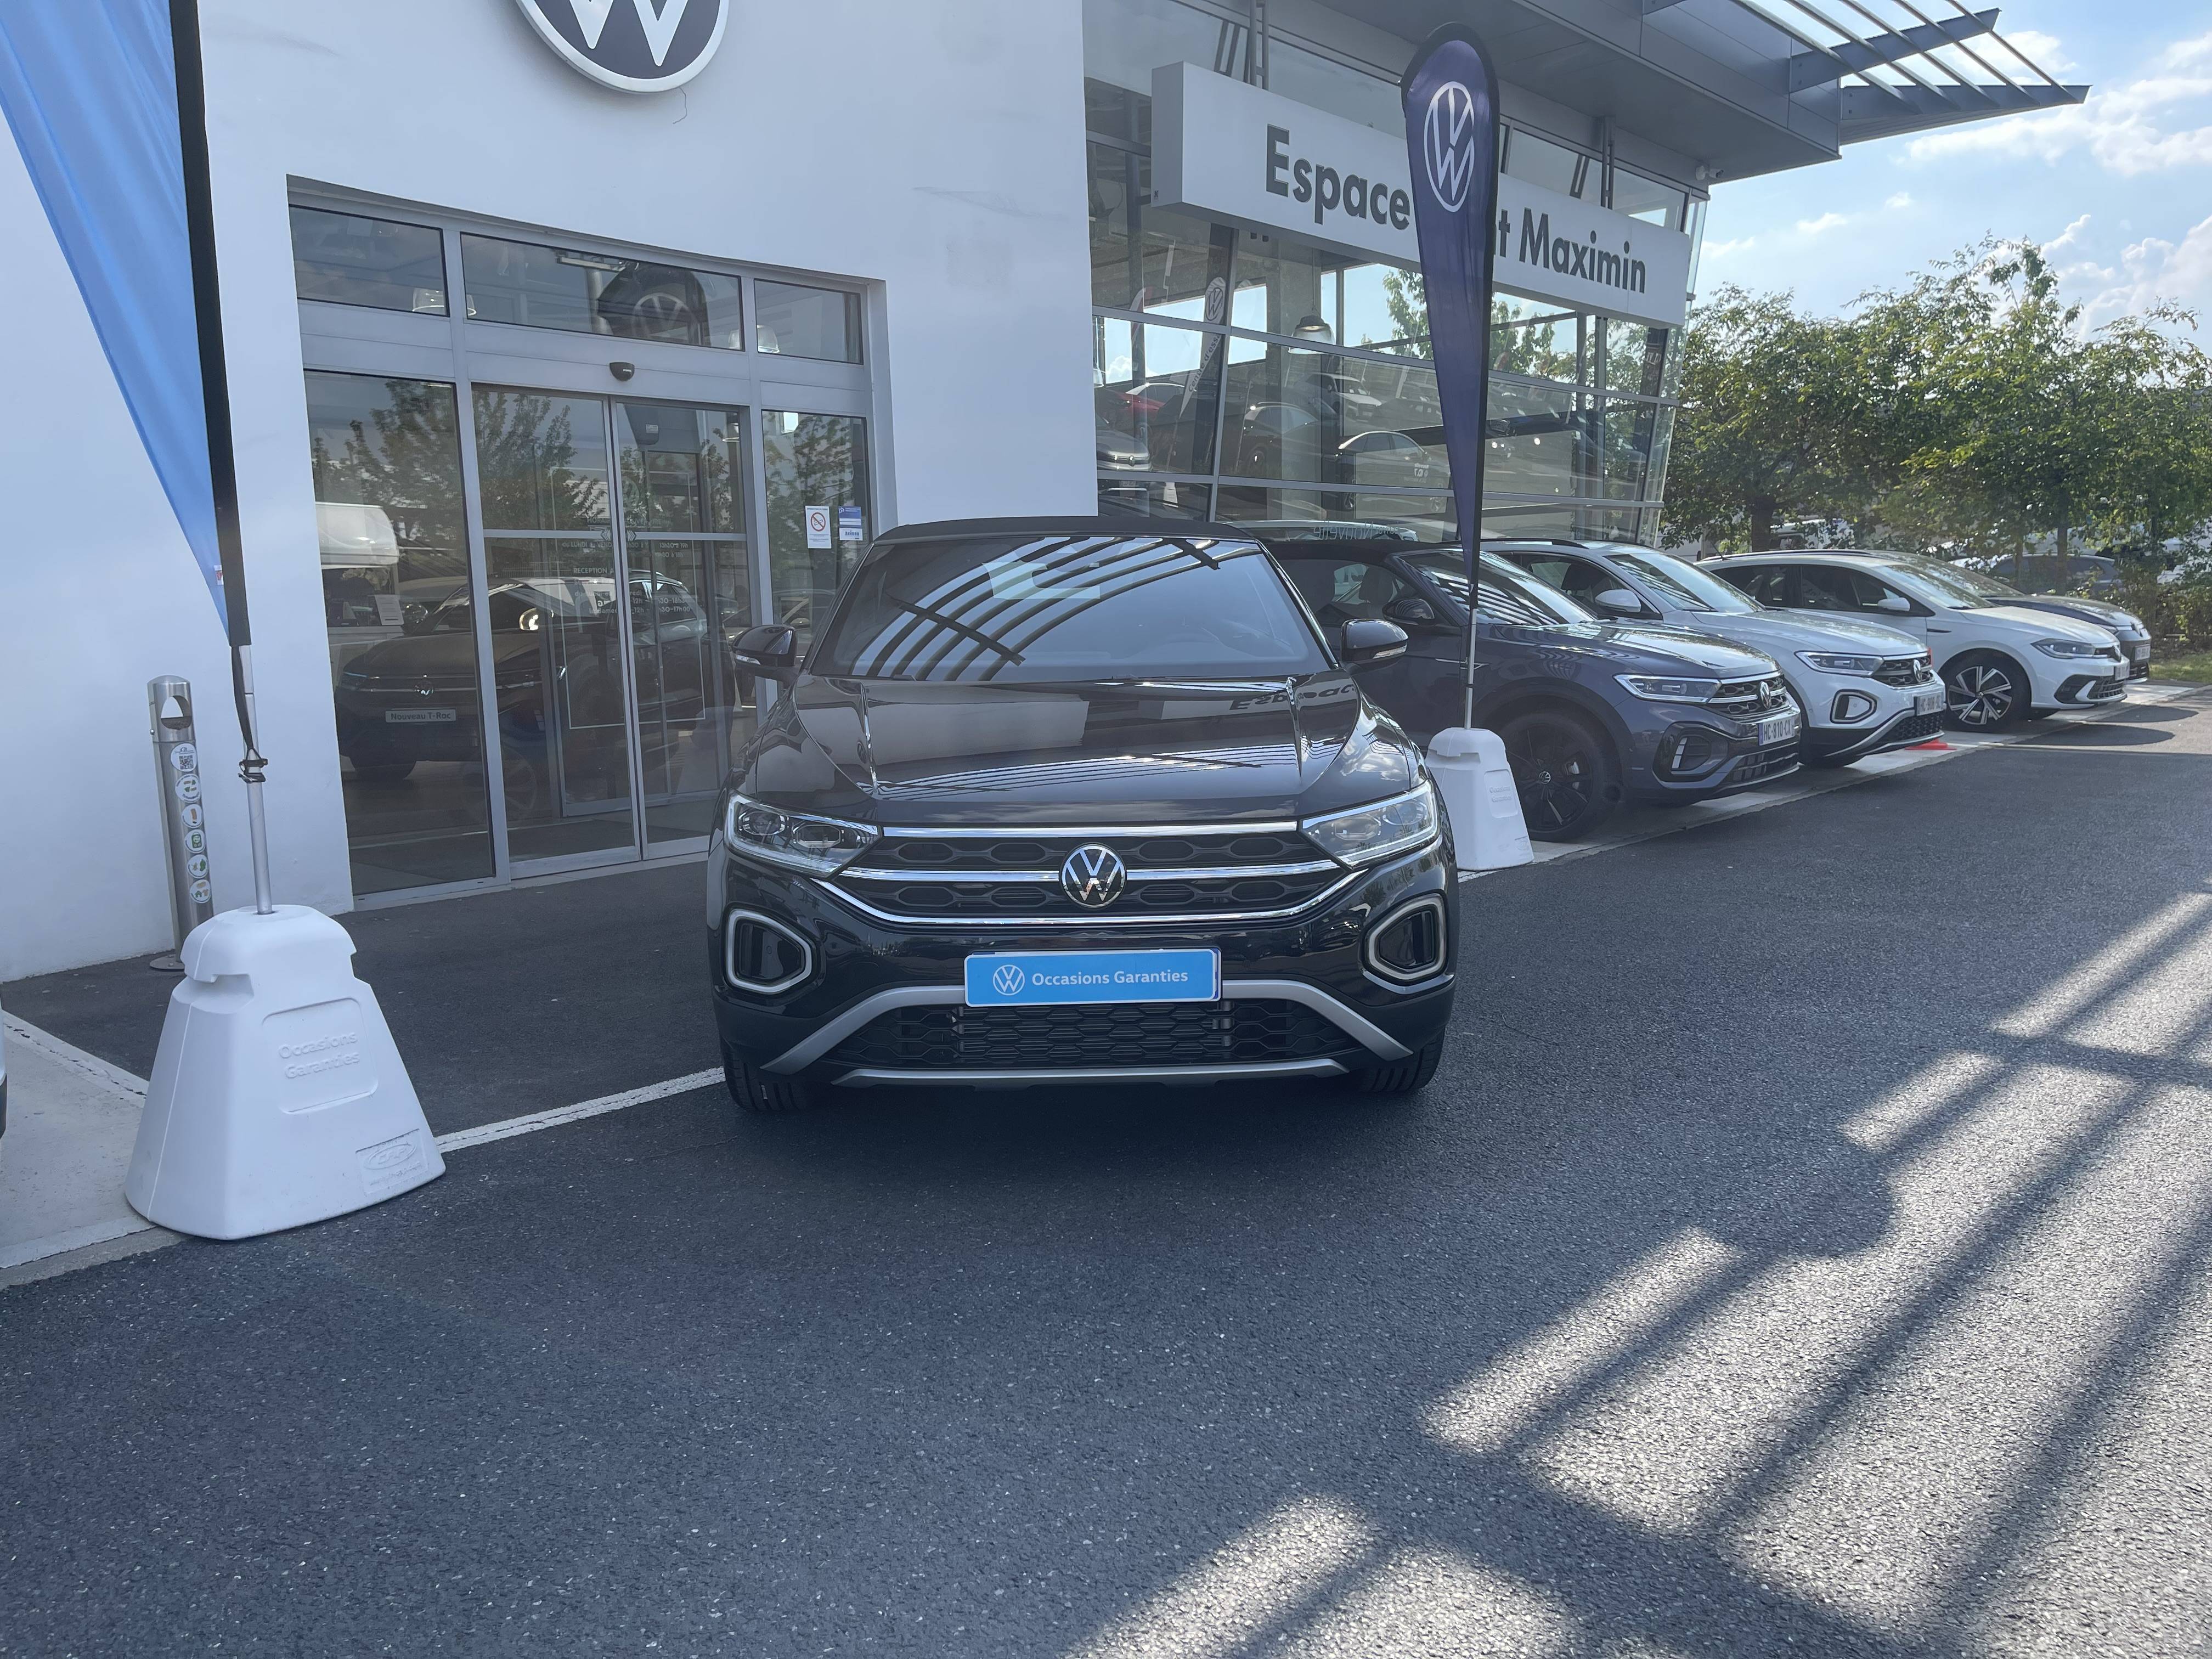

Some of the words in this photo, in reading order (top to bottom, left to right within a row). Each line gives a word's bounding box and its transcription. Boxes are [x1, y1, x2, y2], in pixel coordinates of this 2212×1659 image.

[1266, 123, 1410, 230] Espace
[1519, 207, 1646, 294] Maximin
[1204, 333, 1221, 361] d'essa
[1763, 719, 1791, 741] HC-810-CX
[1032, 971, 1110, 986] Occasions
[1114, 969, 1188, 984] Garanties
[278, 1031, 358, 1059] Occasions
[285, 1052, 360, 1079] Garanties
